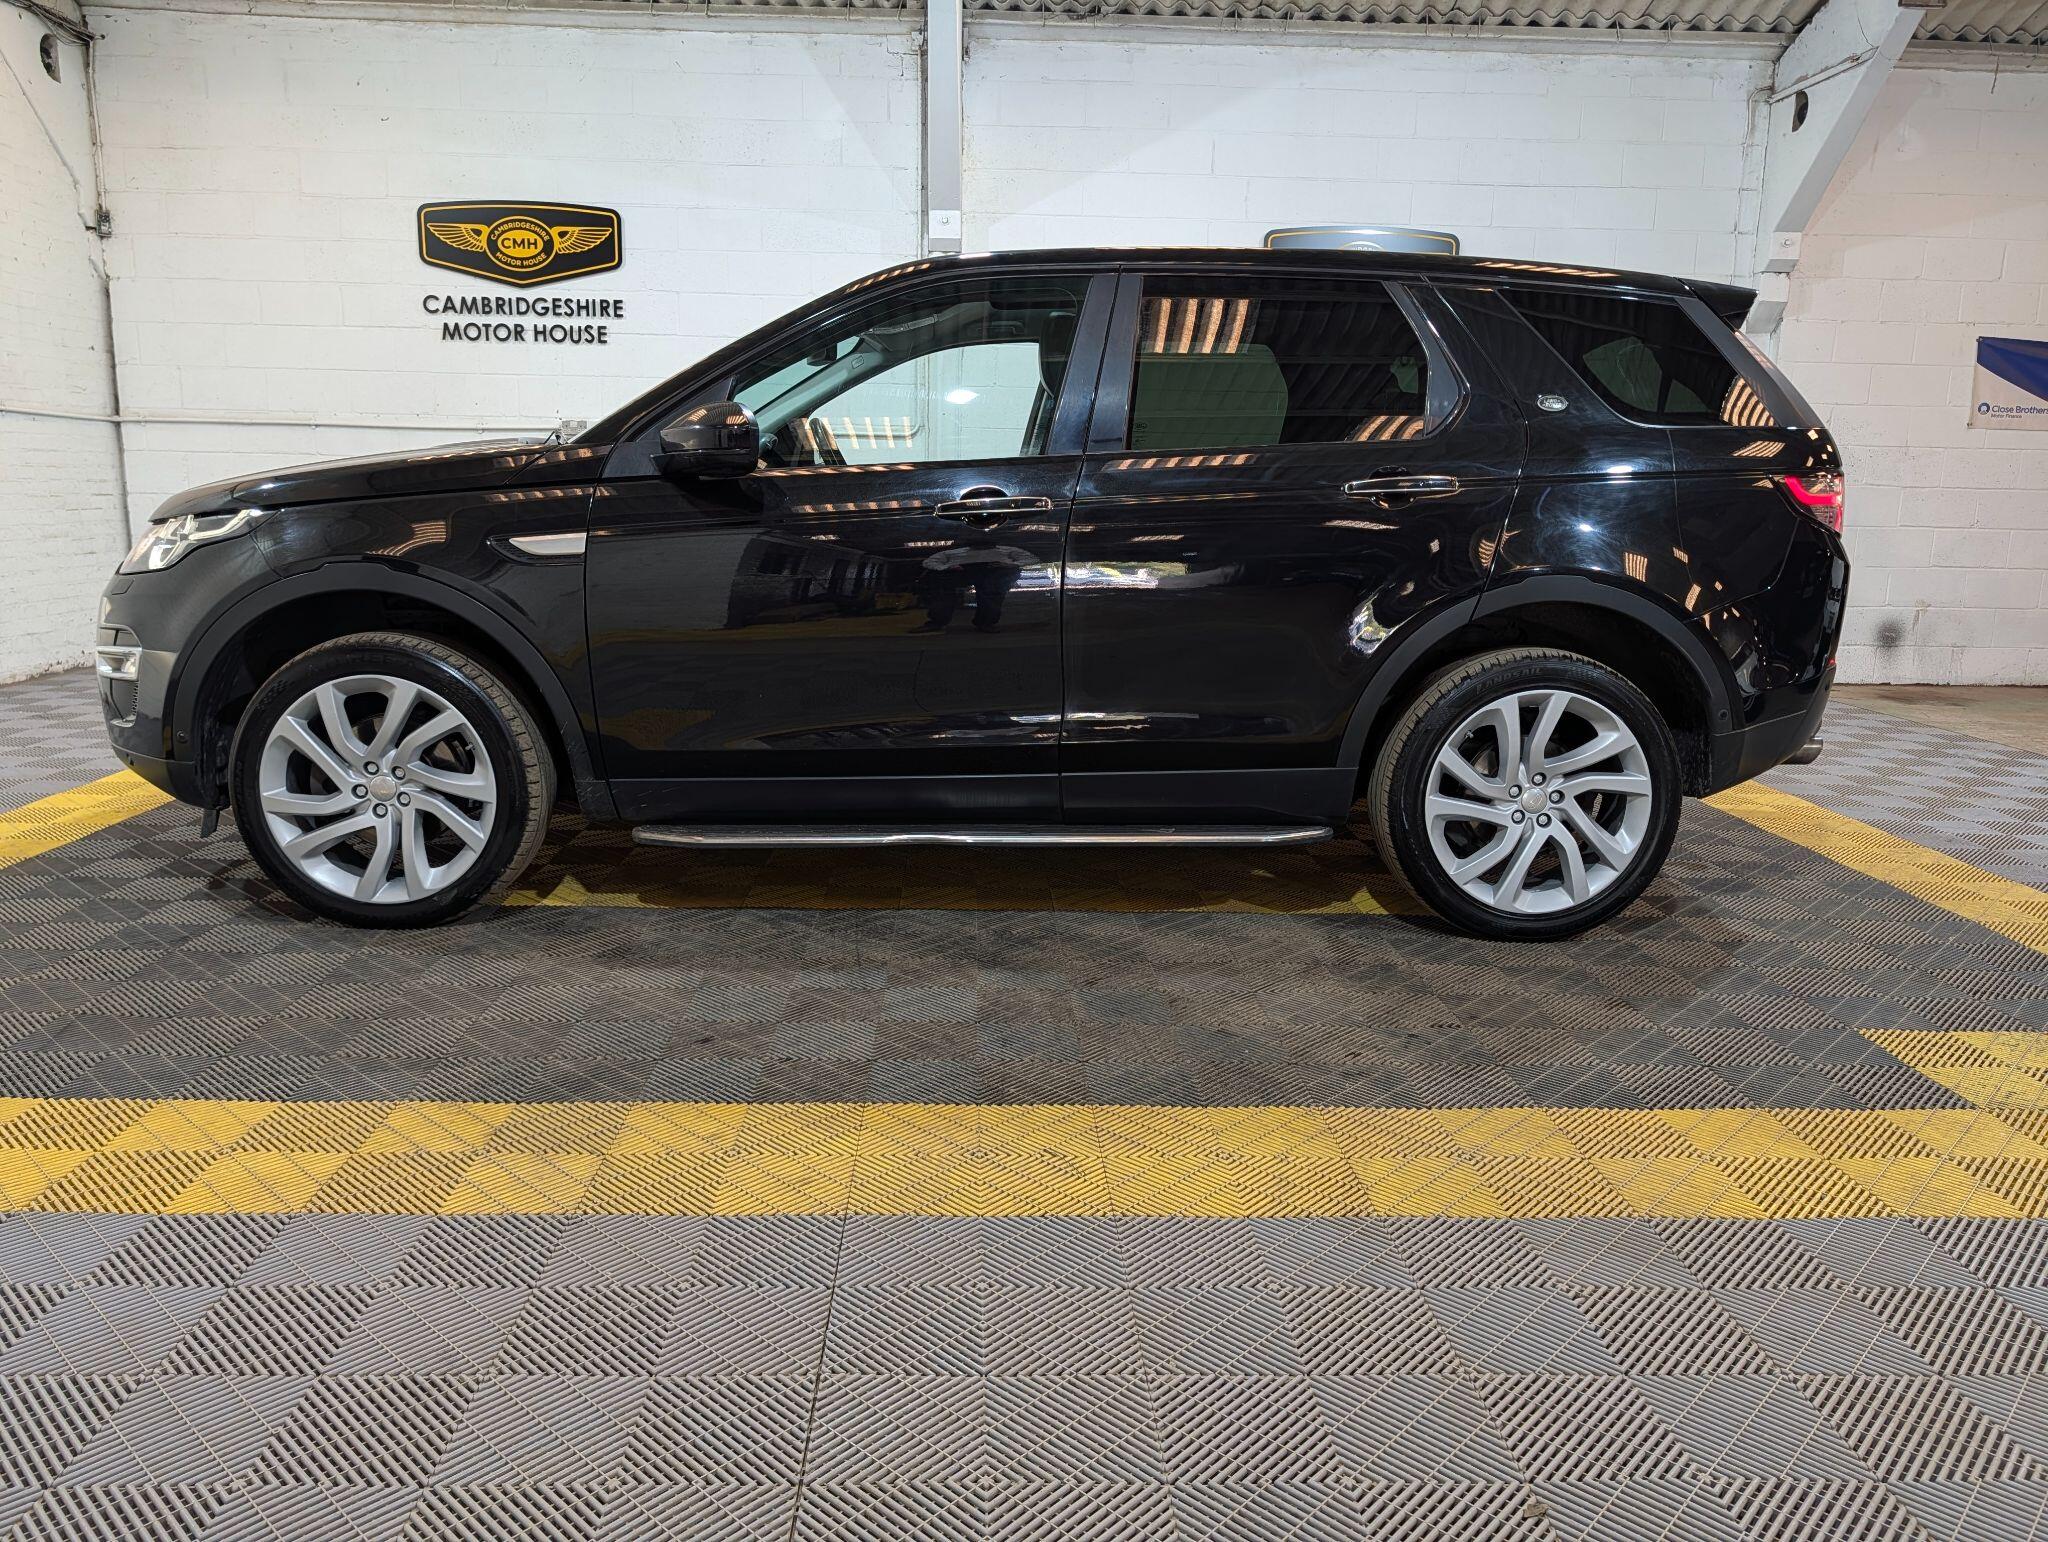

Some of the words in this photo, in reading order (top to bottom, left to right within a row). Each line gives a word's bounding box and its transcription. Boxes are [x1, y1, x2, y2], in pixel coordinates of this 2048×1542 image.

[491, 221, 550, 241] CAMBRIDGESHIRE
[501, 237, 538, 250] CMH
[496, 252, 521, 266] MOTOR
[523, 252, 547, 266] HOUSE
[422, 295, 624, 318] CAMBRIDGESHIRE
[442, 322, 525, 342] MOTOR
[534, 324, 608, 344] HOUSE
[1991, 405, 2014, 413] Close
[2015, 406, 2048, 414] Brothers
